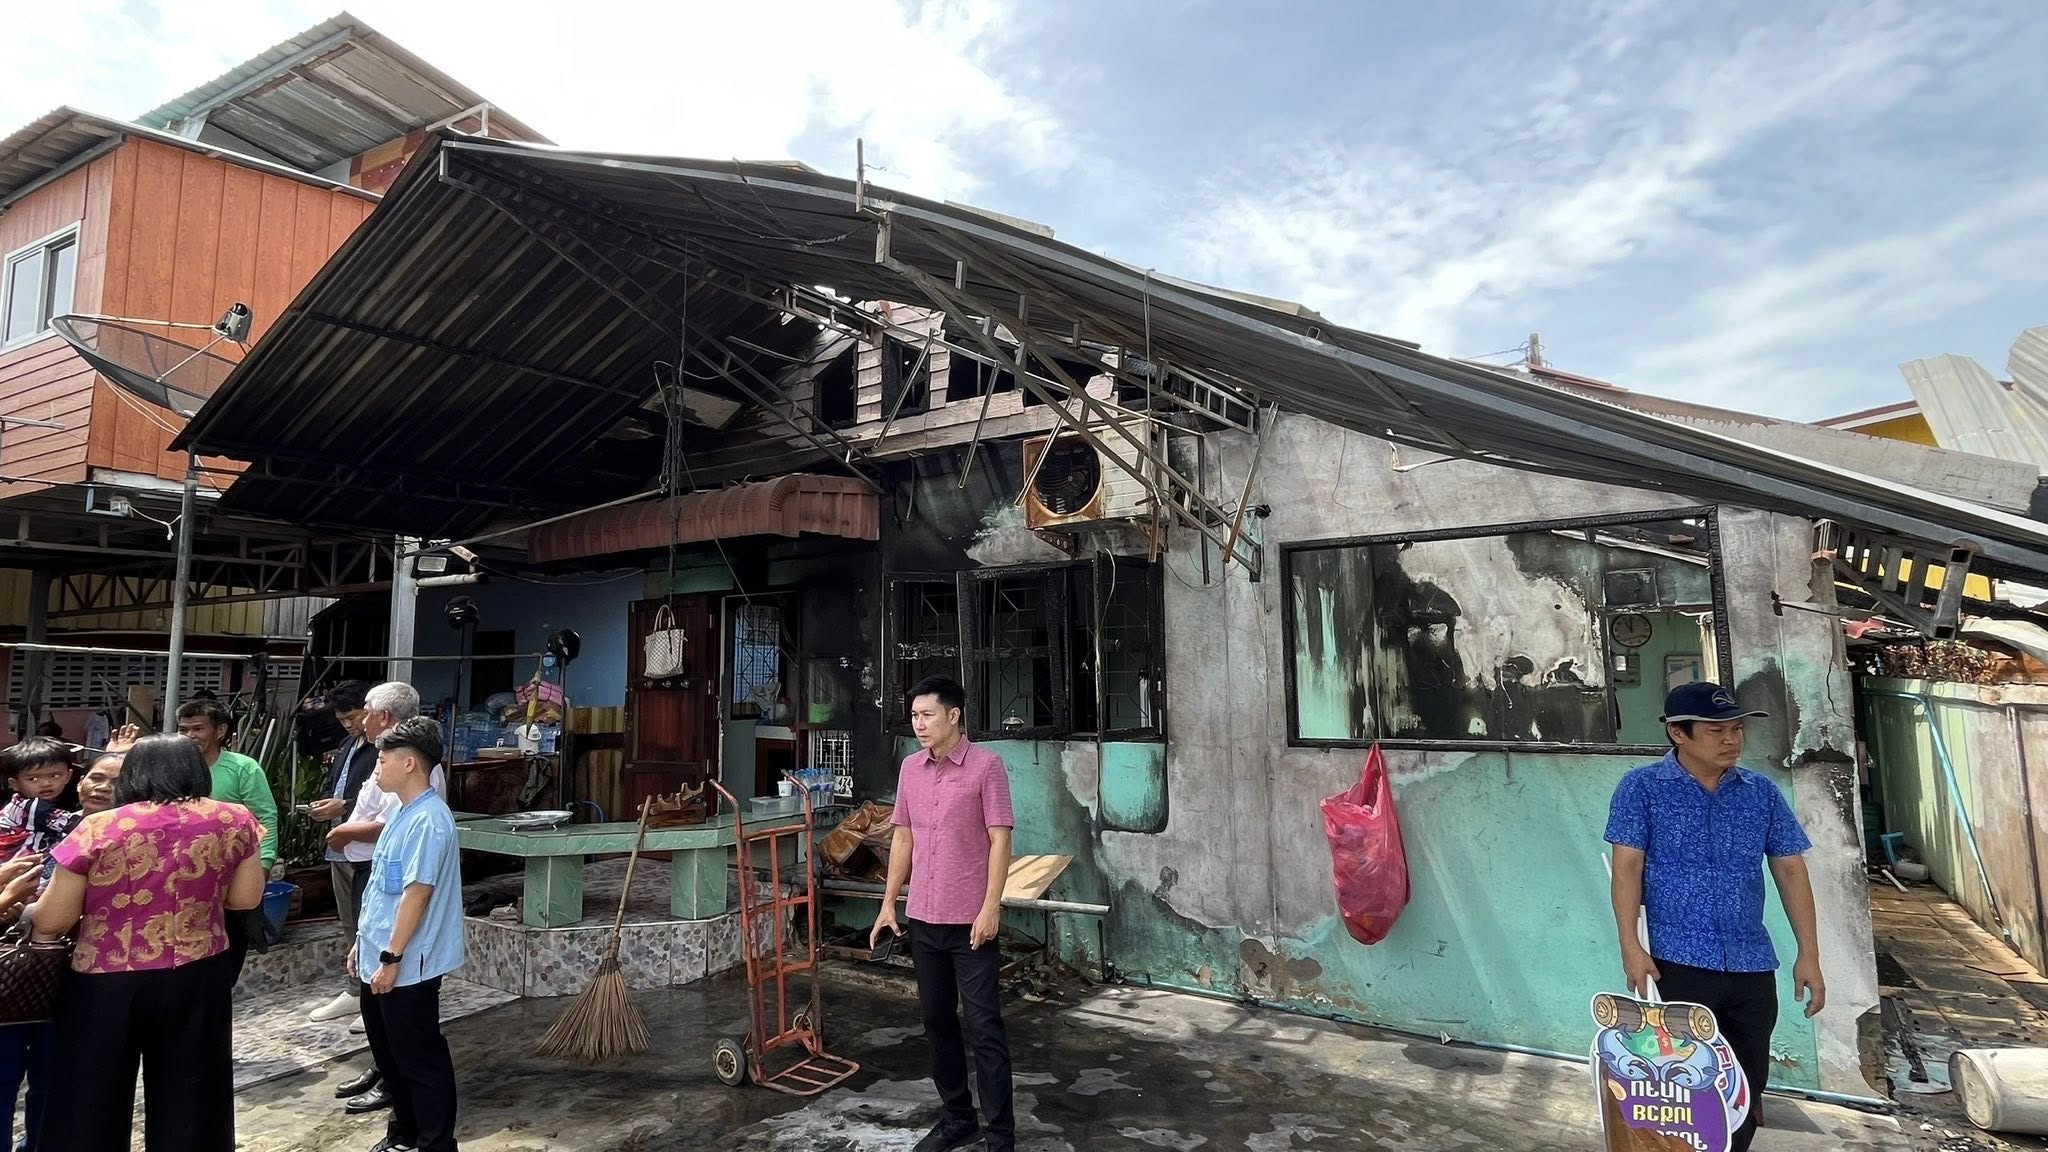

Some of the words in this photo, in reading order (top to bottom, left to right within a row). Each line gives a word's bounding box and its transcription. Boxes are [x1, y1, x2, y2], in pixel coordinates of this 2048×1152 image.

[1631, 1080, 1690, 1103] แก้จน
[1633, 1104, 1693, 1126] ไปช่วย
